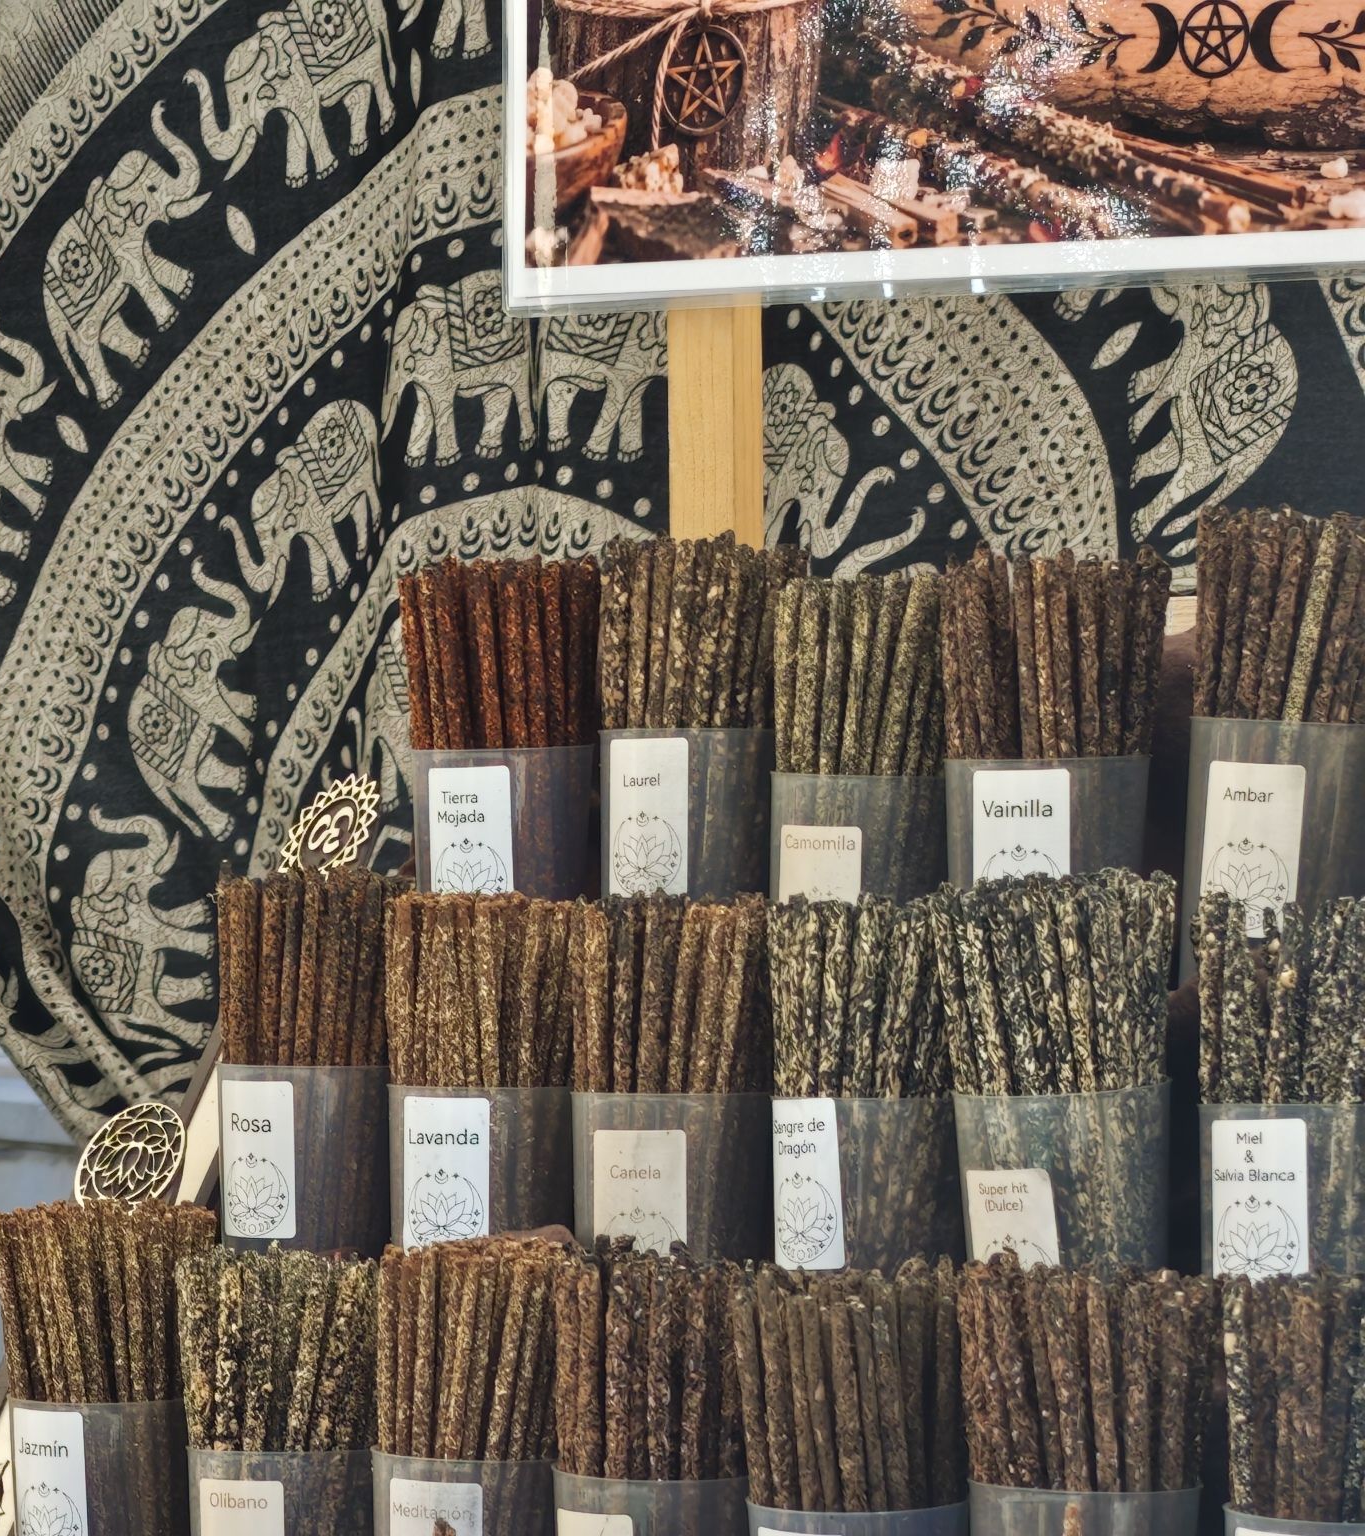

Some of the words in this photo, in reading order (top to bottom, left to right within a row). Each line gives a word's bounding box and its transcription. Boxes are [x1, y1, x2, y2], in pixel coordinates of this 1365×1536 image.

[623, 772, 661, 788] Laurel
[441, 790, 479, 805] Tierra
[1223, 787, 1274, 803] Ambar
[982, 798, 1053, 818] Vainilla
[437, 809, 485, 828] Mojada
[784, 833, 856, 851] Camomila
[231, 1112, 272, 1133] Rosa
[773, 1118, 805, 1138] Sangre
[809, 1118, 826, 1133] de
[408, 1128, 480, 1146] Lavanda
[1236, 1131, 1263, 1145] Miel
[778, 1139, 817, 1159] Dragón
[1243, 1149, 1255, 1164] &
[609, 1164, 661, 1180] Canela
[1214, 1168, 1244, 1182] Salvia
[1248, 1168, 1296, 1182] Blanca
[978, 1182, 1008, 1198] Super
[1011, 1182, 1029, 1194] hit
[984, 1197, 1024, 1213] (Dulce)
[19, 1437, 69, 1458] Jazmín
[209, 1491, 268, 1511] Olibano
[392, 1501, 472, 1521] Meditación
